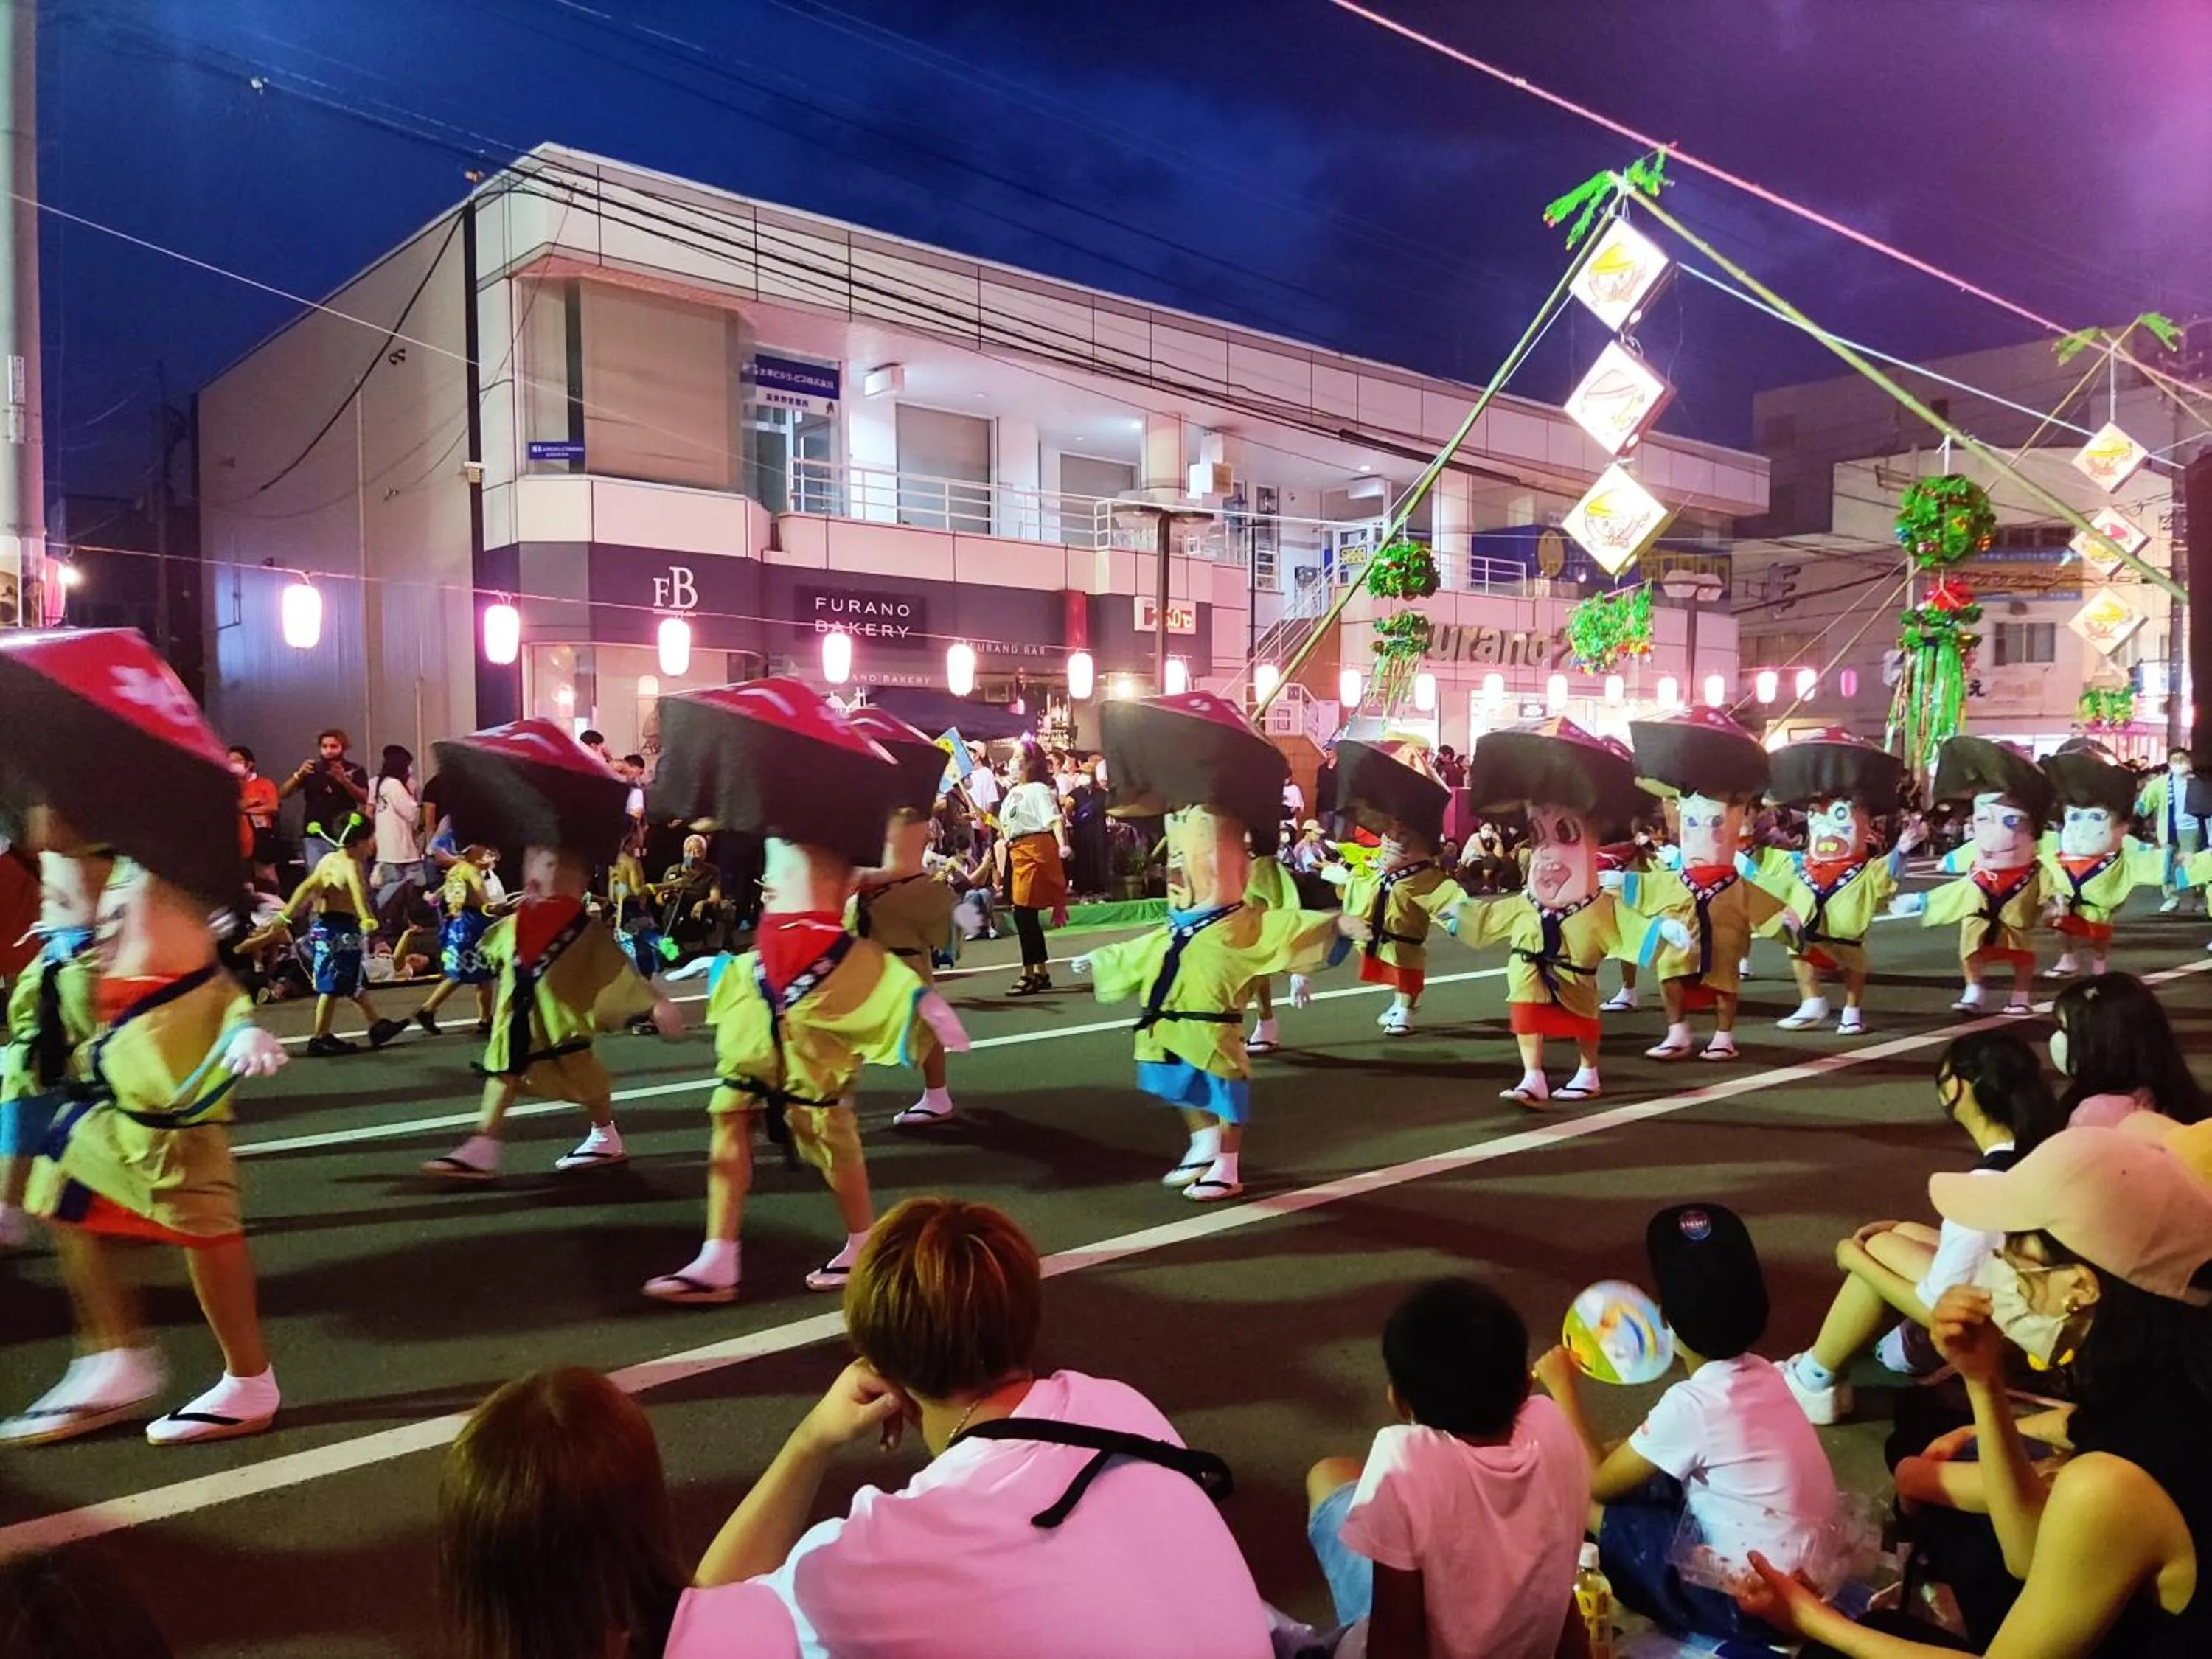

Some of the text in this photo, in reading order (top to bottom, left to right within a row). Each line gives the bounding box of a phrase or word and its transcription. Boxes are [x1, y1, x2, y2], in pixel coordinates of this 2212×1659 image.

[653, 566, 698, 608] FB
[815, 597, 910, 617] FURANO
[815, 619, 909, 638] BAKERY
[1428, 625, 1552, 667] urano
[883, 675, 931, 684] BAKERY
